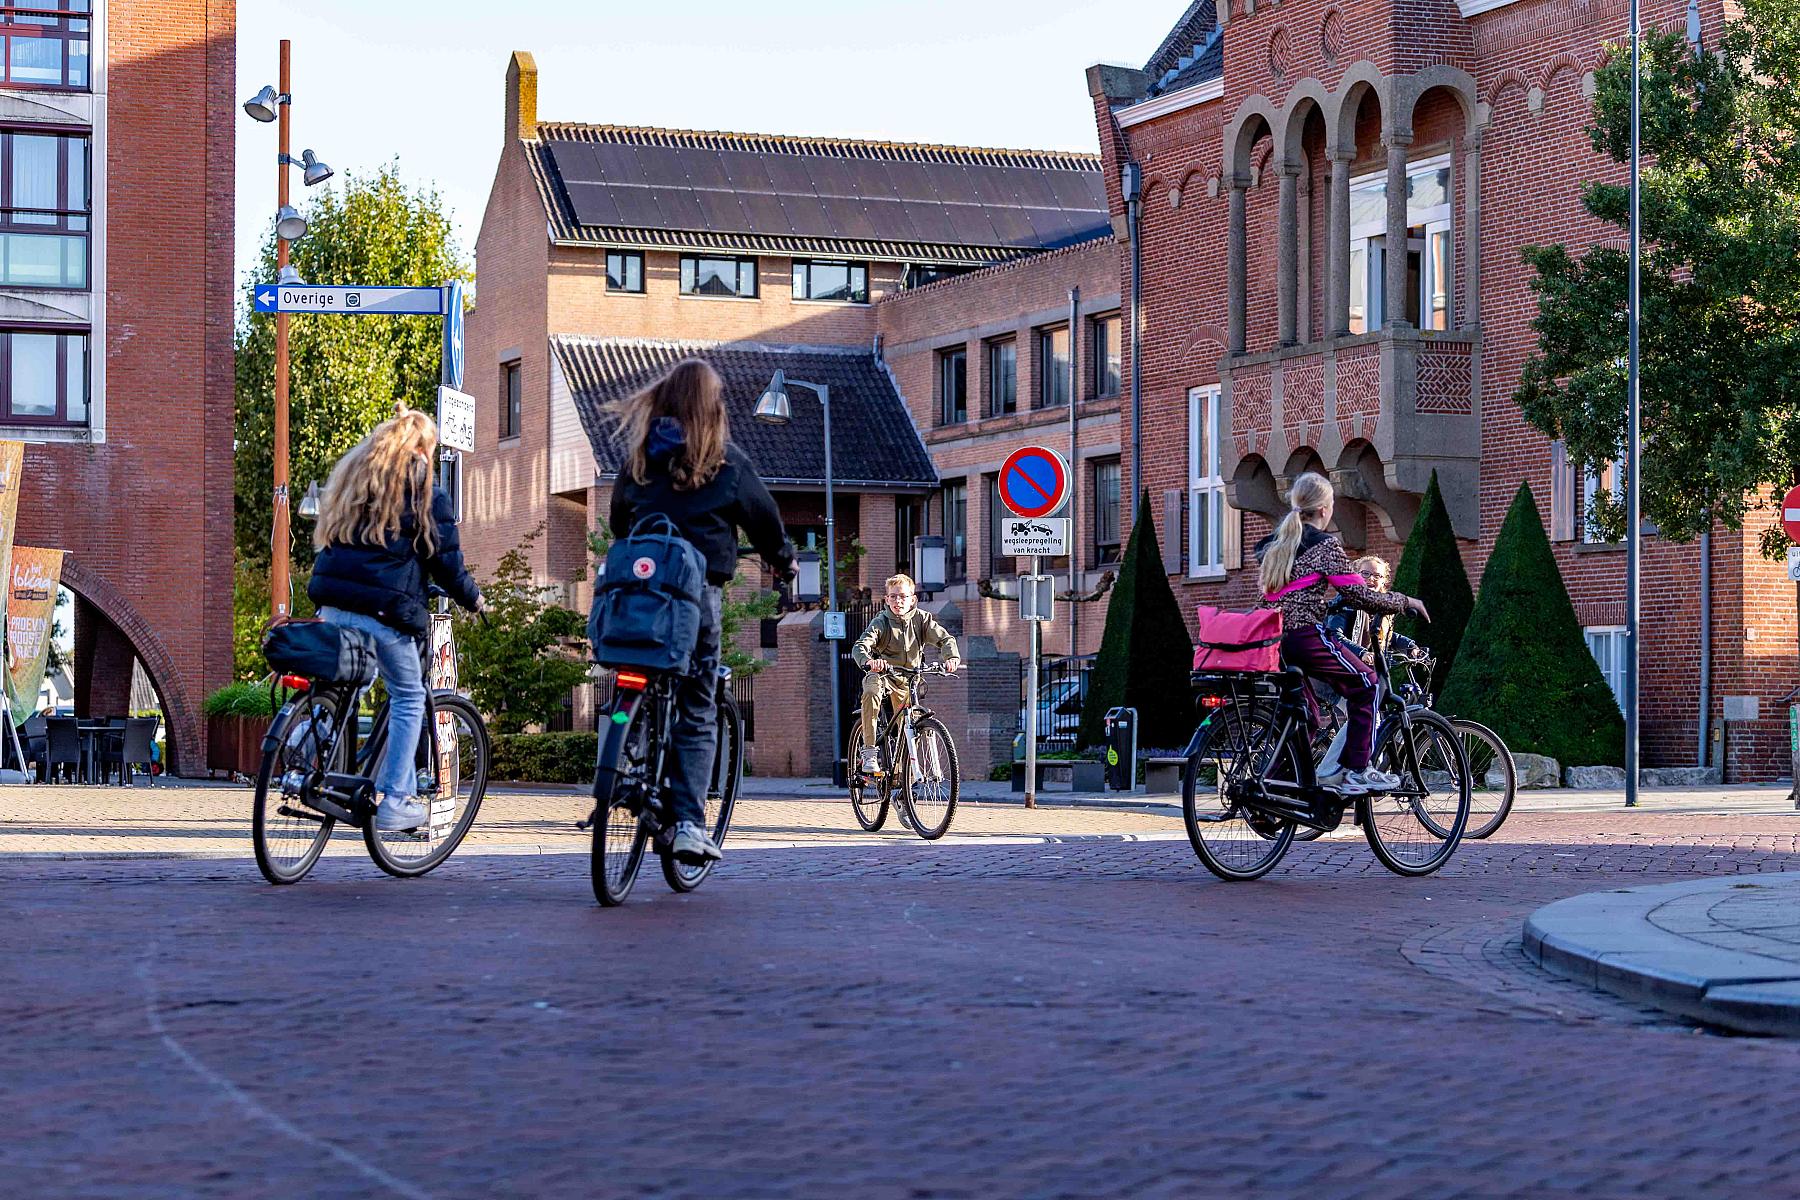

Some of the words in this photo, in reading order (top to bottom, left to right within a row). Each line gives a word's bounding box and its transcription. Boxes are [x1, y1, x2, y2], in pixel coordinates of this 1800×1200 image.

[283, 291, 334, 308] Overige
[1003, 537, 1062, 546] wegsleepregeling
[1026, 546, 1051, 554] kracht
